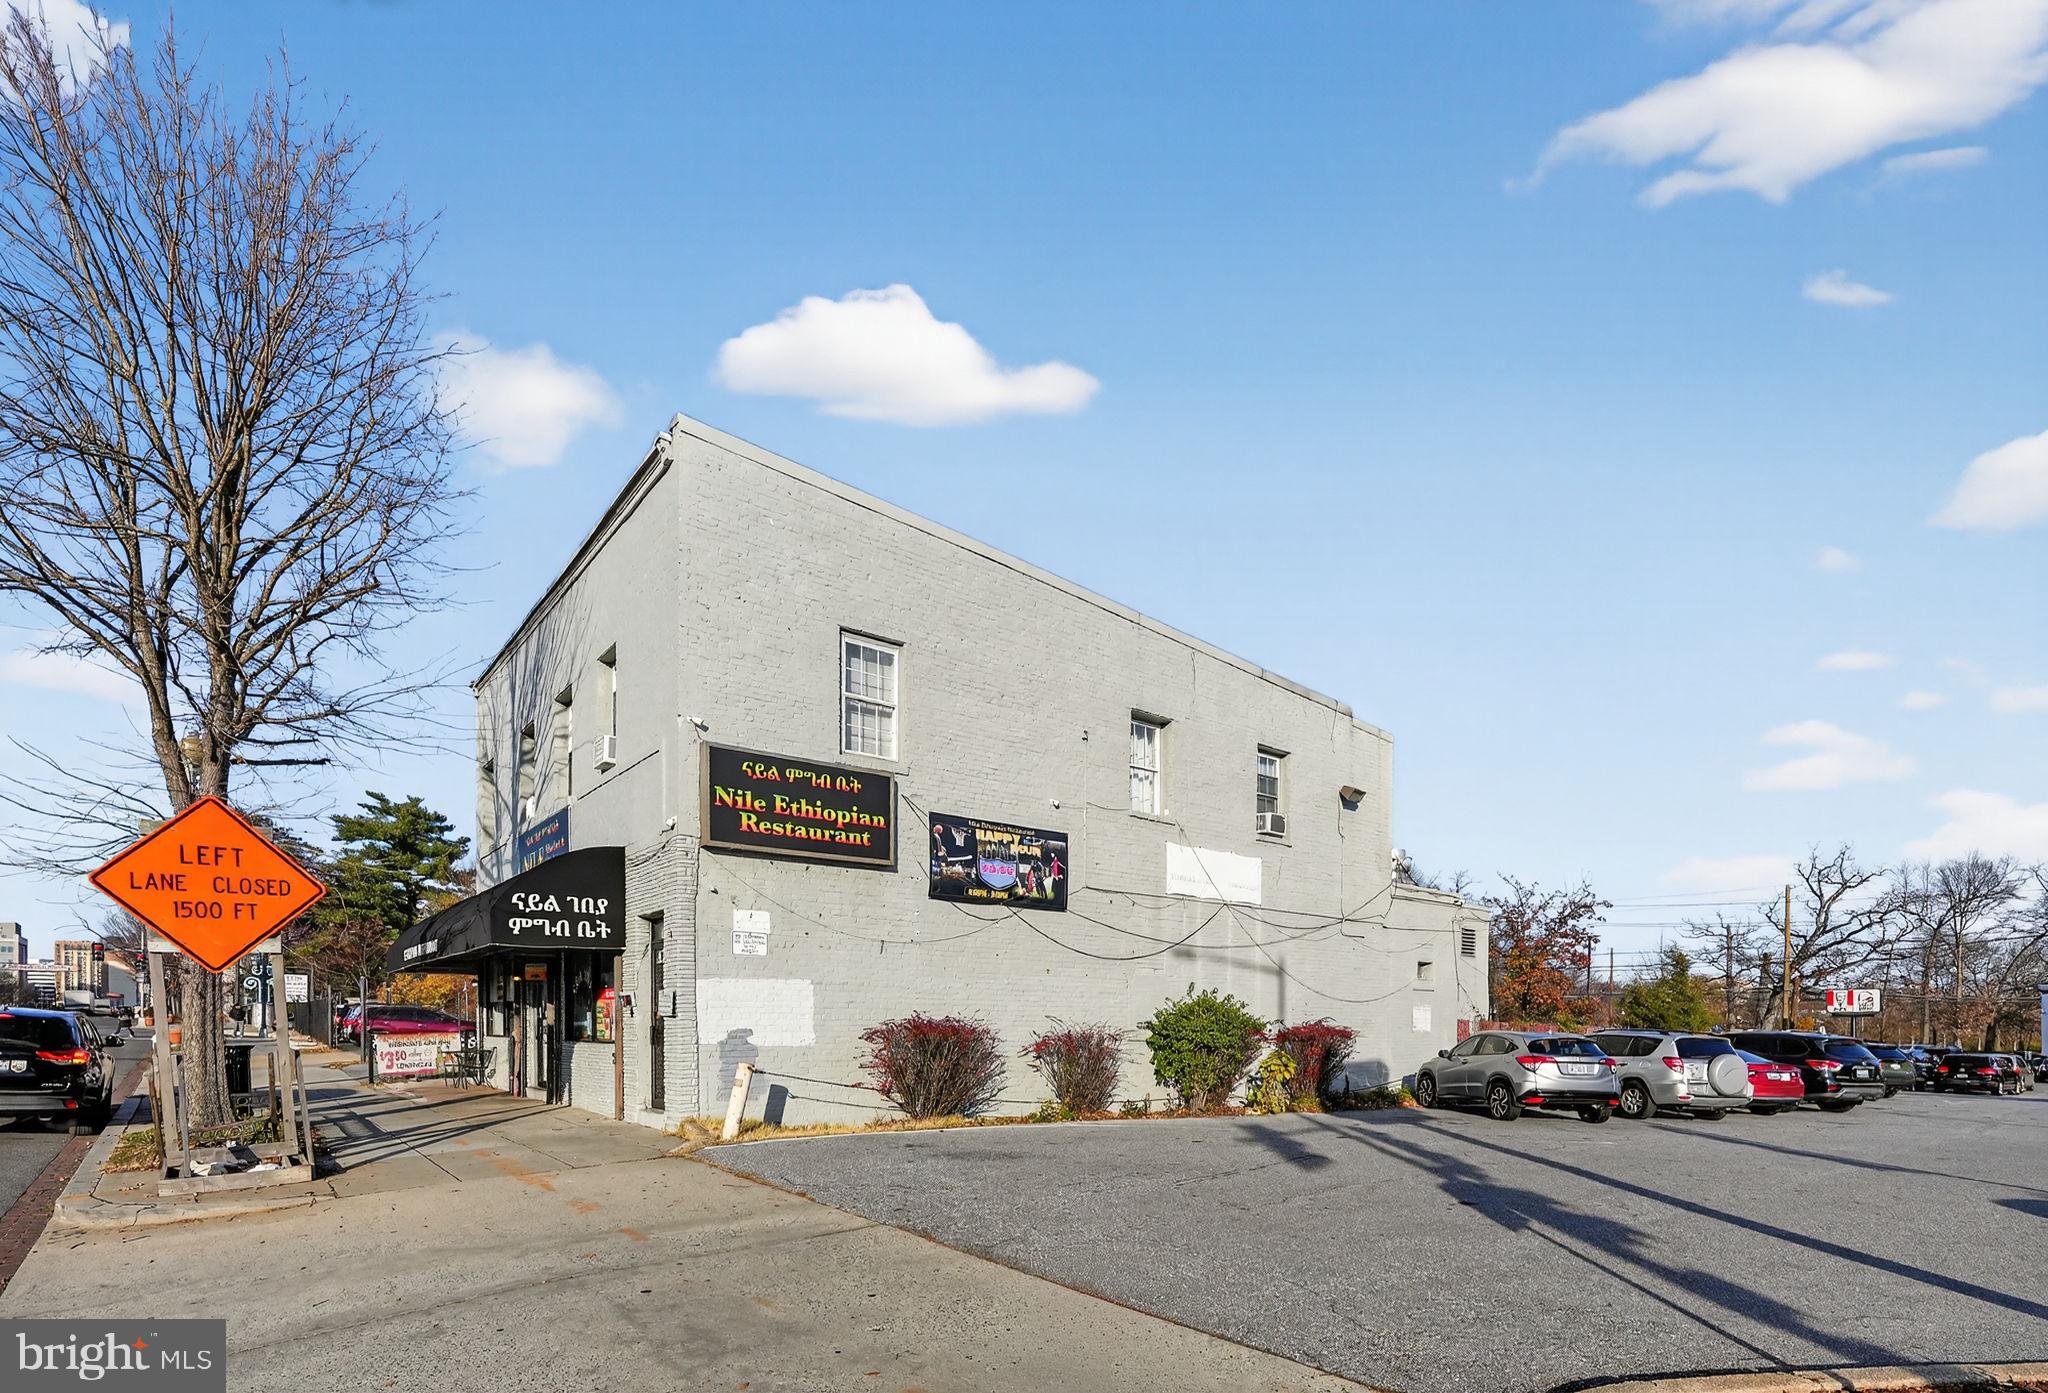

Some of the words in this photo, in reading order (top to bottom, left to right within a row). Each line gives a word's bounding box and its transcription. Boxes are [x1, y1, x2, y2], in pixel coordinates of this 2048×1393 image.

[742, 761, 781, 782] ናይል
[785, 768, 831, 789] ምግብ
[836, 776, 862, 794] ቤት
[713, 785, 767, 812] Nile
[773, 794, 887, 829] Ethiopian
[739, 811, 872, 847] Restaurant
[179, 844, 244, 867] LEFT
[129, 872, 187, 892] LANE
[213, 876, 291, 897] CLOSED
[172, 901, 223, 919] 1500
[234, 903, 258, 920] FT
[511, 892, 561, 913] ናይል
[566, 896, 608, 915] ገበያ
[508, 917, 571, 937] ምግብ
[577, 920, 611, 939] ቤት
